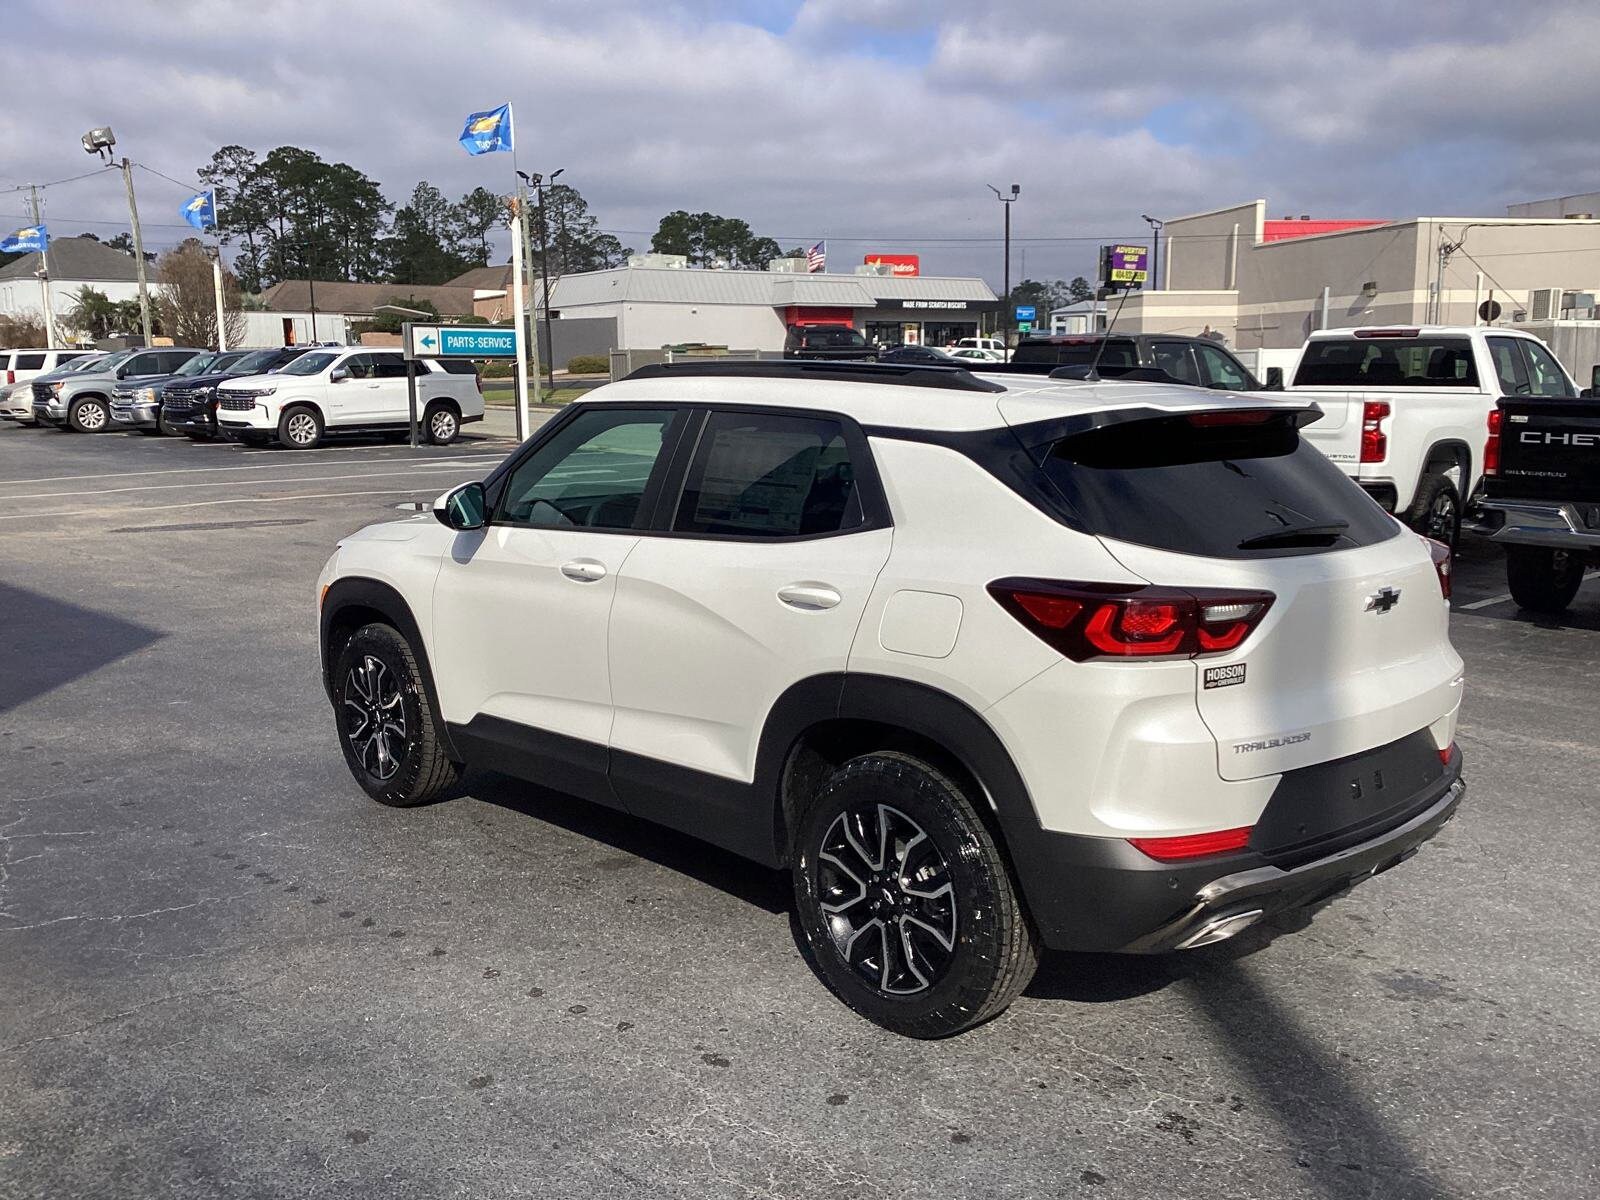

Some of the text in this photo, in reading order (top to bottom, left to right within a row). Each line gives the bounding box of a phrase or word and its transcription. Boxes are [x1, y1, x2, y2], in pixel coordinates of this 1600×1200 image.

[447, 336, 512, 349] PARTS-SERVICE
[1519, 431, 1600, 446] CHE
[1206, 664, 1245, 681] HOBSON
[1217, 675, 1245, 687] CHEVROLET
[1233, 732, 1312, 754] TRAILBLAZER
